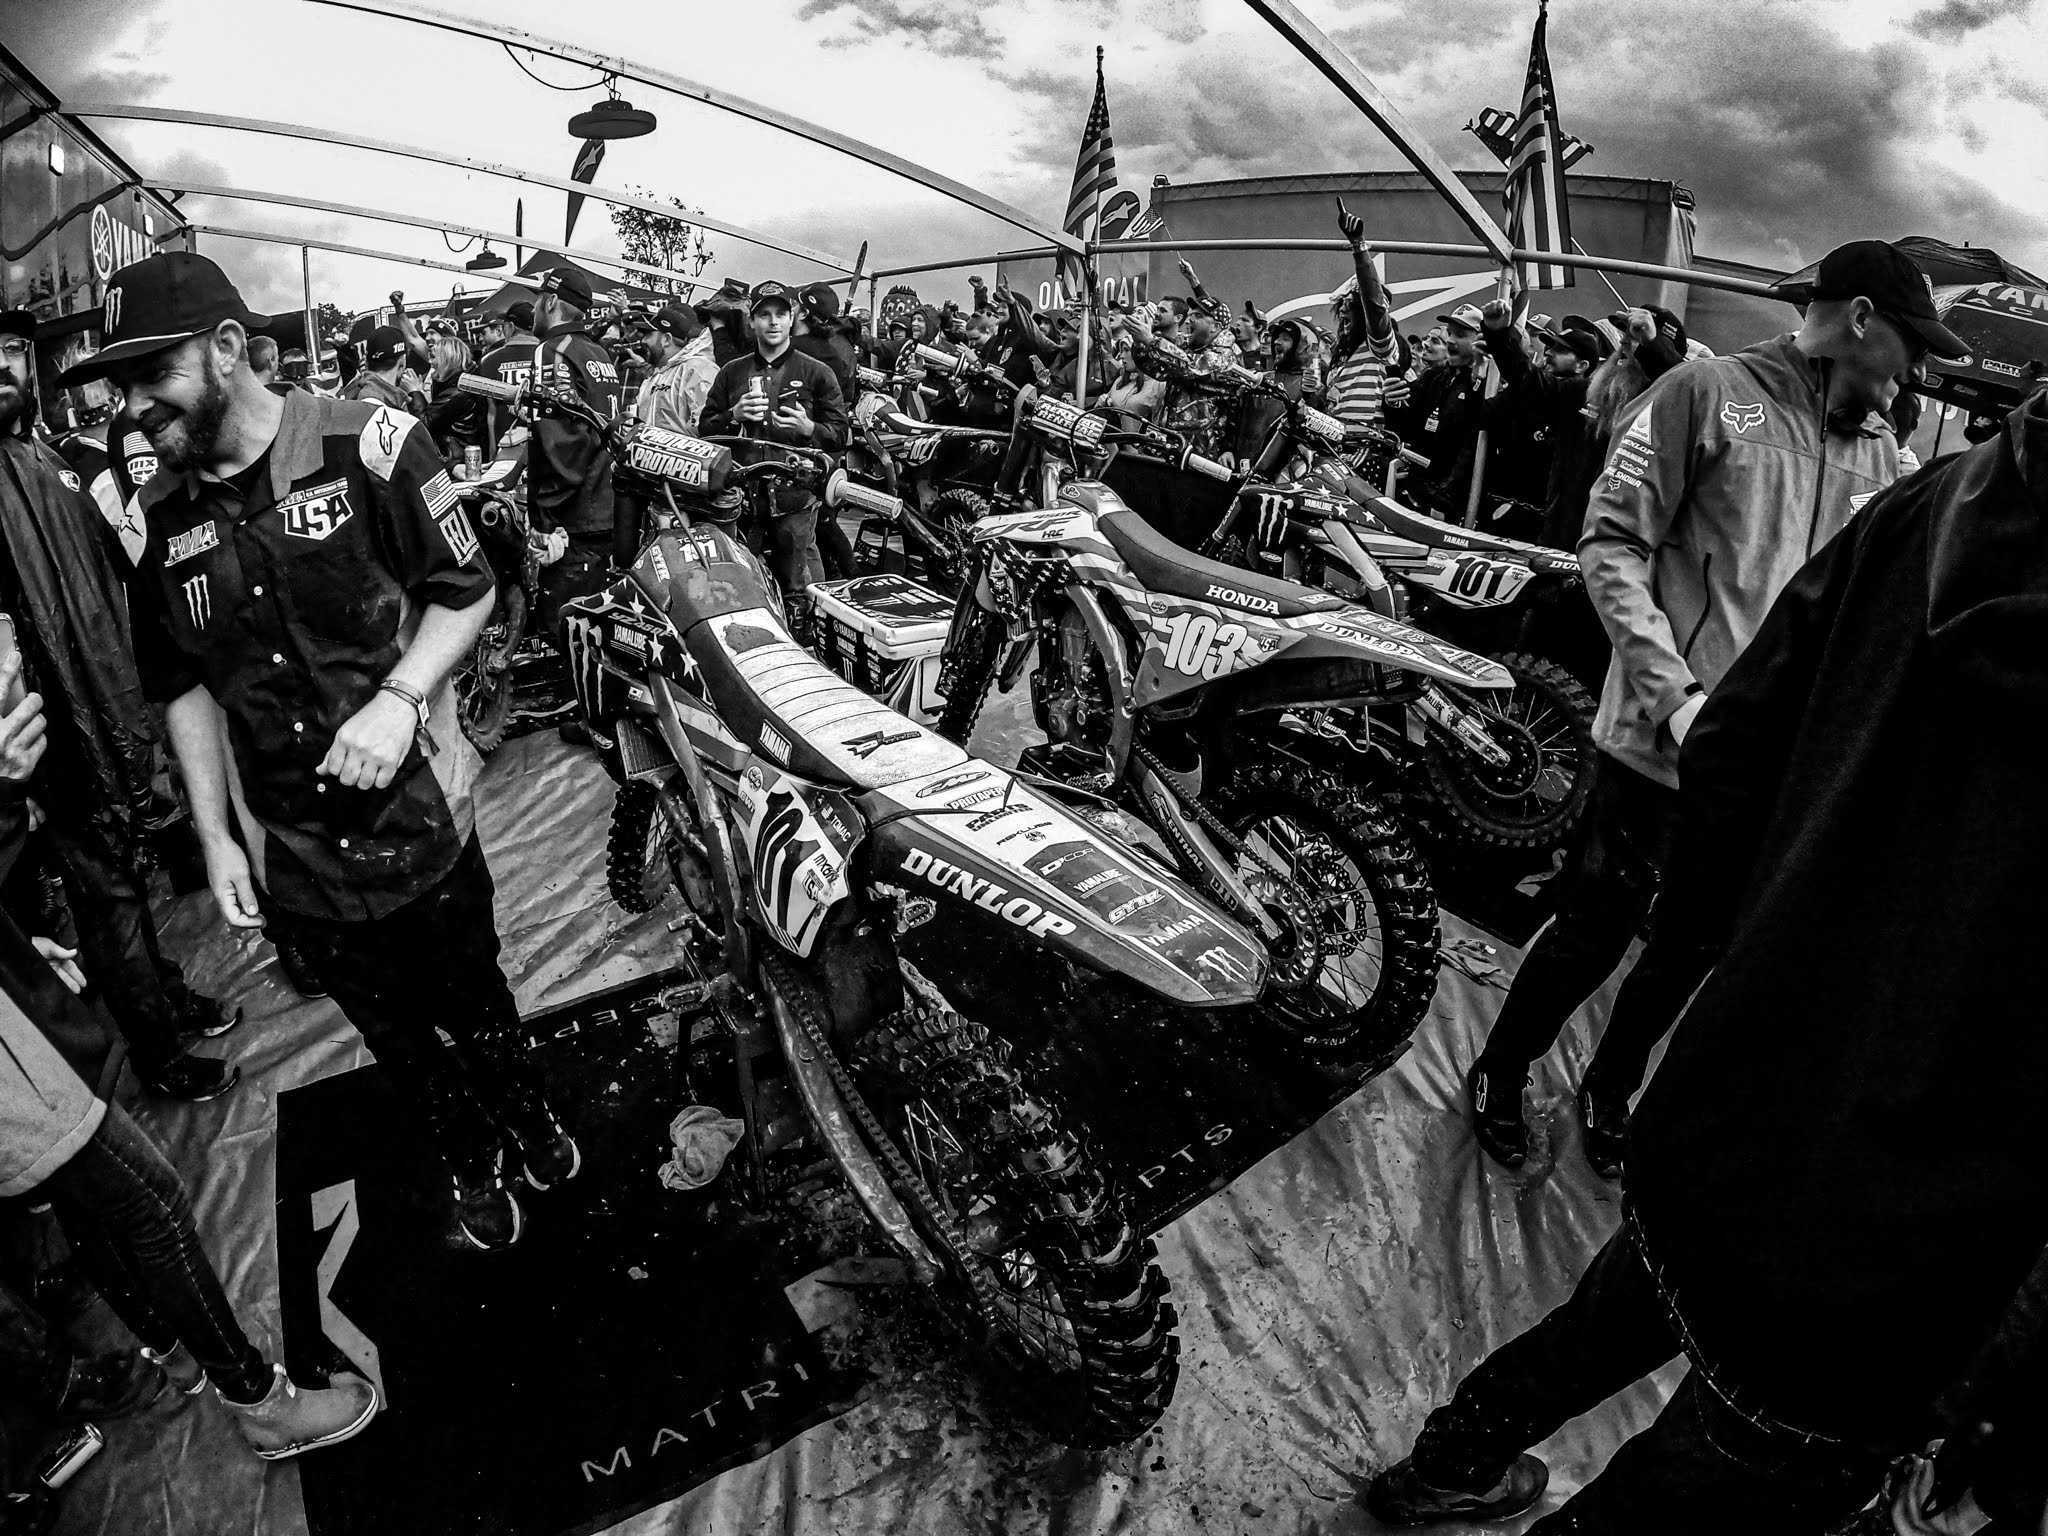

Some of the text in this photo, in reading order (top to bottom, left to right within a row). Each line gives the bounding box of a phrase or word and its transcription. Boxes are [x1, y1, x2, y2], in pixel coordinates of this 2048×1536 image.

[634, 446, 700, 486] PROTAPER
[286, 493, 352, 540] USA
[1443, 534, 1469, 548] YAMAHA
[1448, 556, 1510, 600] 101
[1549, 560, 1582, 572] DUN
[1205, 584, 1280, 615] HONDA
[1163, 612, 1248, 681] 103
[1317, 622, 1414, 656] DUNLOP
[759, 719, 792, 769] YAMAHA
[831, 814, 852, 843] TOMAC
[901, 848, 1077, 938] DUNLOP
[1142, 914, 1205, 946] YAMAHA
[581, 1362, 808, 1482] MATRI
